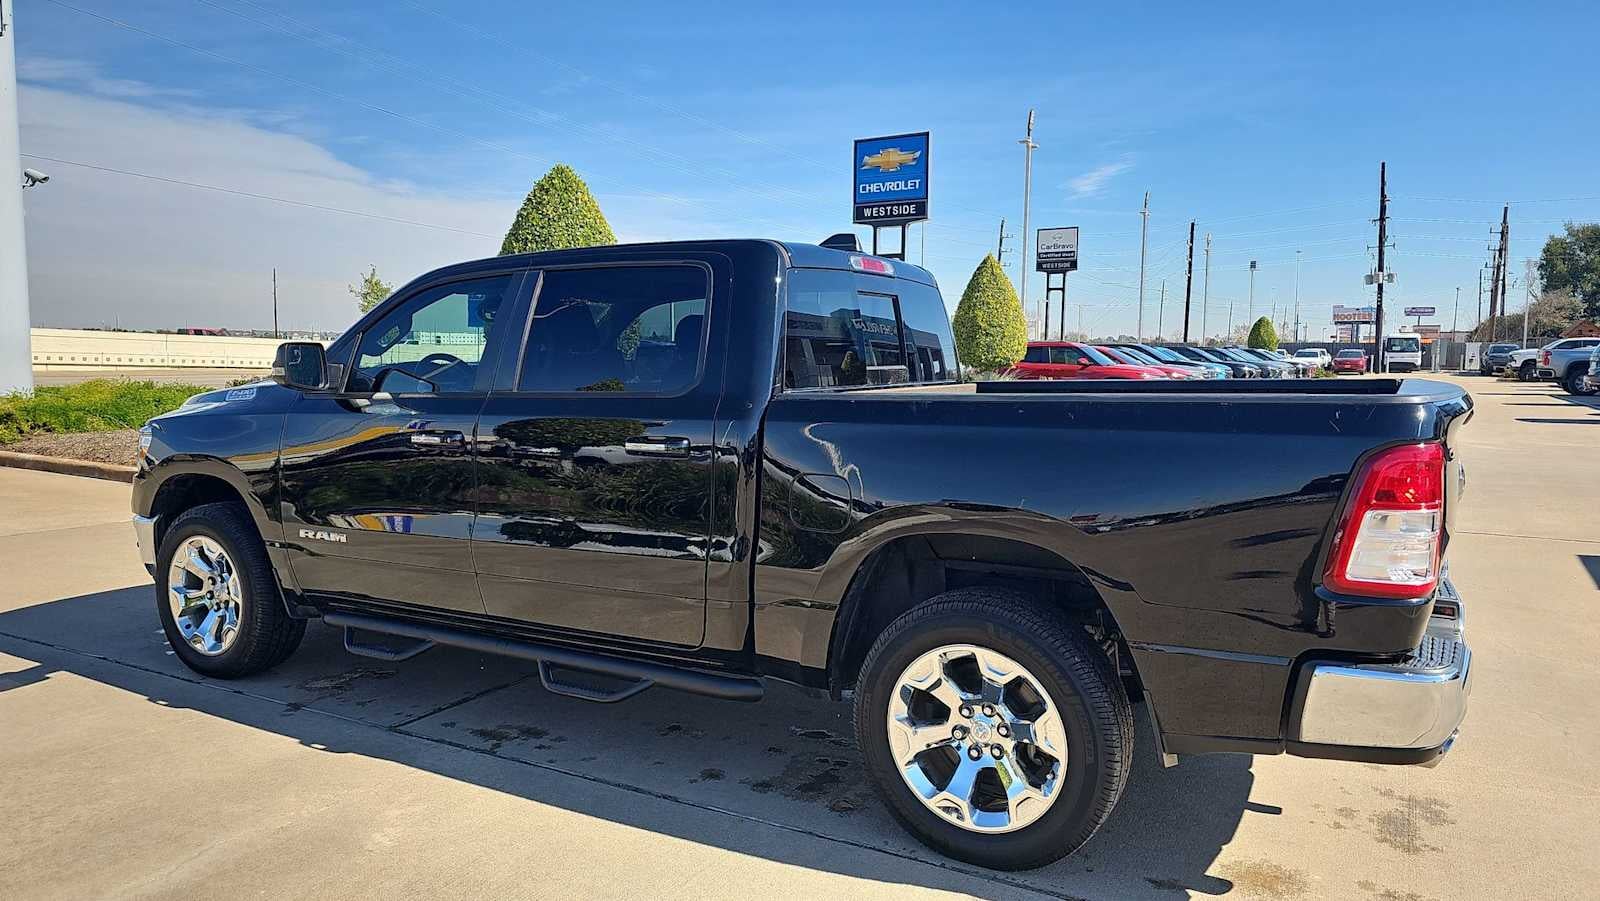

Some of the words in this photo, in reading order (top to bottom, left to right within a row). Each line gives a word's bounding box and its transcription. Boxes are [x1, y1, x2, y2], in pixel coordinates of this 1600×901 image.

[860, 179, 920, 194] CHEVROLET
[863, 204, 916, 216] WESTSIDE
[1333, 313, 1373, 321] HOOTERS
[299, 528, 347, 543] RAM
